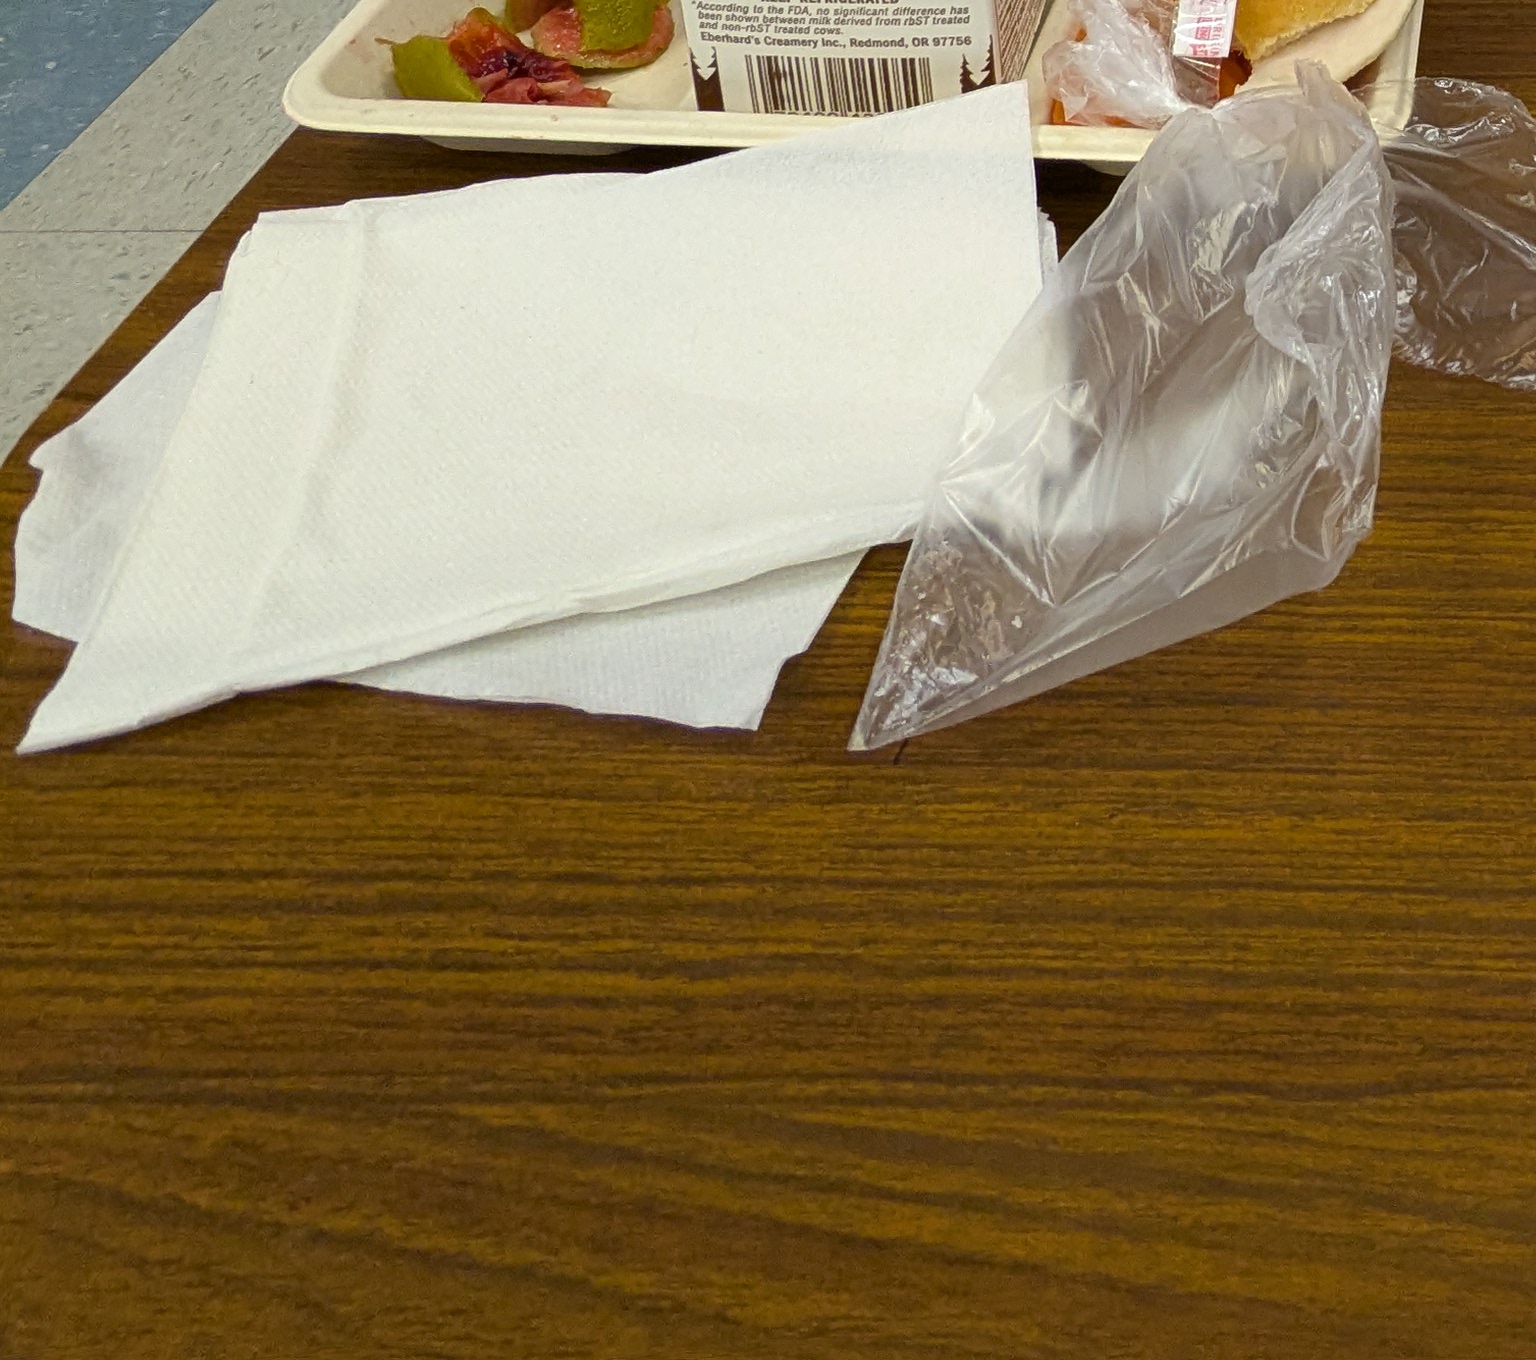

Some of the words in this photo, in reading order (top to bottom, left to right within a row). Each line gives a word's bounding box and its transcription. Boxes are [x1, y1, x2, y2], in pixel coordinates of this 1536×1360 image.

[753, 3, 764, 15] to
[767, 4, 784, 15] the
[787, 4, 812, 17] FDA,
[833, 6, 889, 18] significant
[892, 6, 947, 17] difference
[950, 6, 970, 16] has
[698, 11, 723, 21] been
[724, 12, 760, 24] shown
[762, 13, 807, 26] between
[808, 14, 831, 26] milk
[833, 15, 873, 27] derived
[875, 16, 902, 27] from
[904, 16, 931, 27] rbST
[932, 15, 971, 26] treated
[721, 22, 772, 34] non-rbST
[774, 24, 811, 35] treated
[813, 26, 844, 36] cows.
[700, 31, 761, 45] Eberhard's
[763, 36, 819, 50] Creamery
[822, 36, 847, 49] Inc.,
[850, 38, 909, 49] Redmond,
[912, 36, 930, 47] OR
[932, 35, 973, 47] 97756
